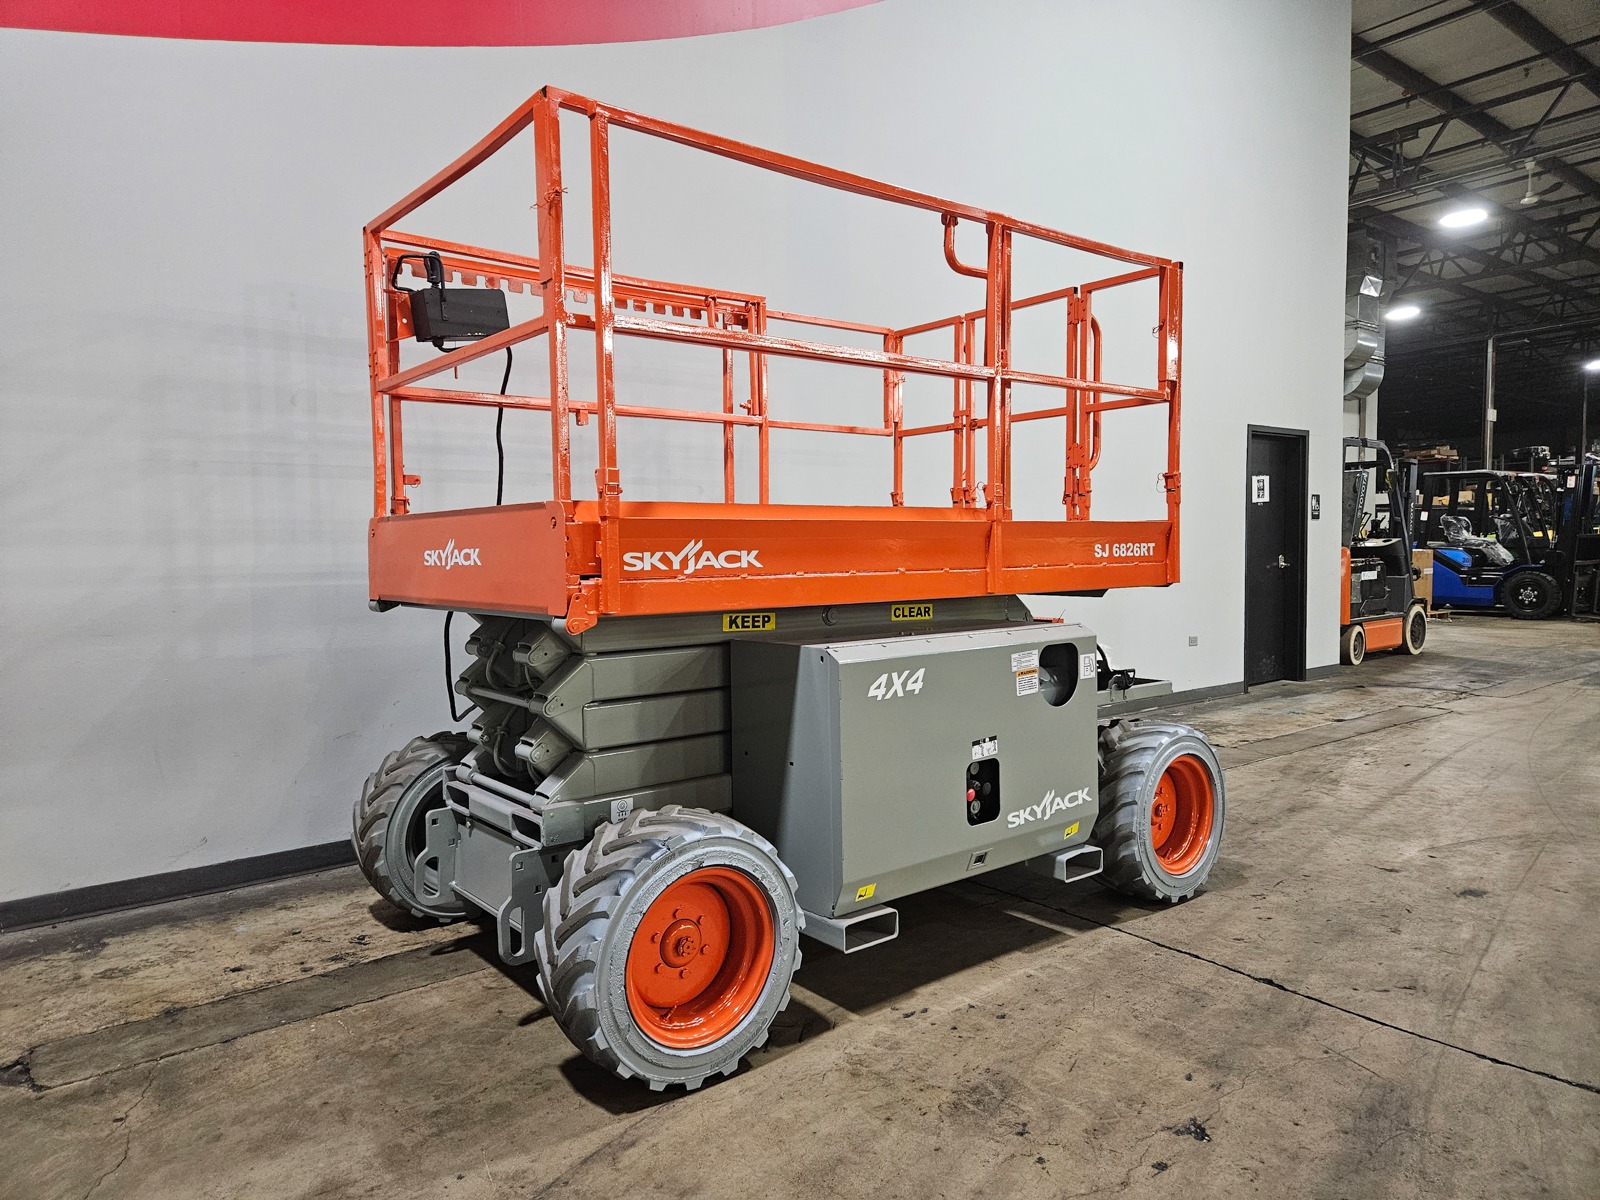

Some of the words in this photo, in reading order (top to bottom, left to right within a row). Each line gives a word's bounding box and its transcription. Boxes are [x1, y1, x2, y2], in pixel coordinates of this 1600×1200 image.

[1358, 472, 1369, 509] TOYOTA
[423, 538, 482, 571] SKYJACK
[622, 538, 764, 575] SKYJACK
[1094, 543, 1110, 558] SJ
[1112, 541, 1156, 558] 6826RT
[728, 614, 771, 630] KEEP
[893, 605, 932, 620] CLEAR
[867, 667, 926, 701] 4X4
[1007, 787, 1093, 829] SKYJACK
